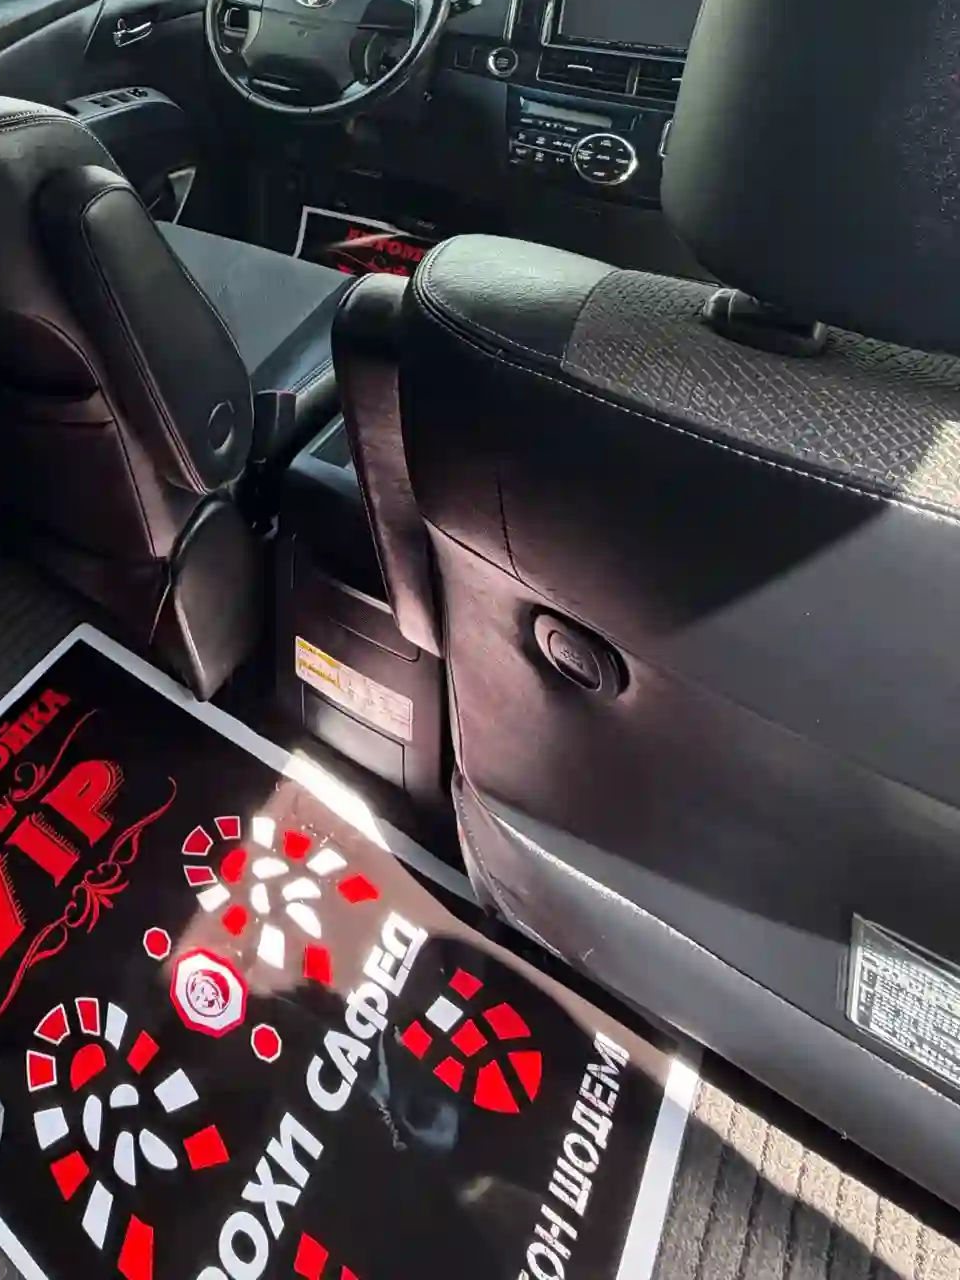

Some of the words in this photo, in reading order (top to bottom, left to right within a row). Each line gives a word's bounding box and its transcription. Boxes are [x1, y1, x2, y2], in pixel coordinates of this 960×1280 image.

[196, 1112, 324, 1280] ОХИ
[306, 911, 429, 1112] САФЕД
[518, 1204, 578, 1280] ОН
